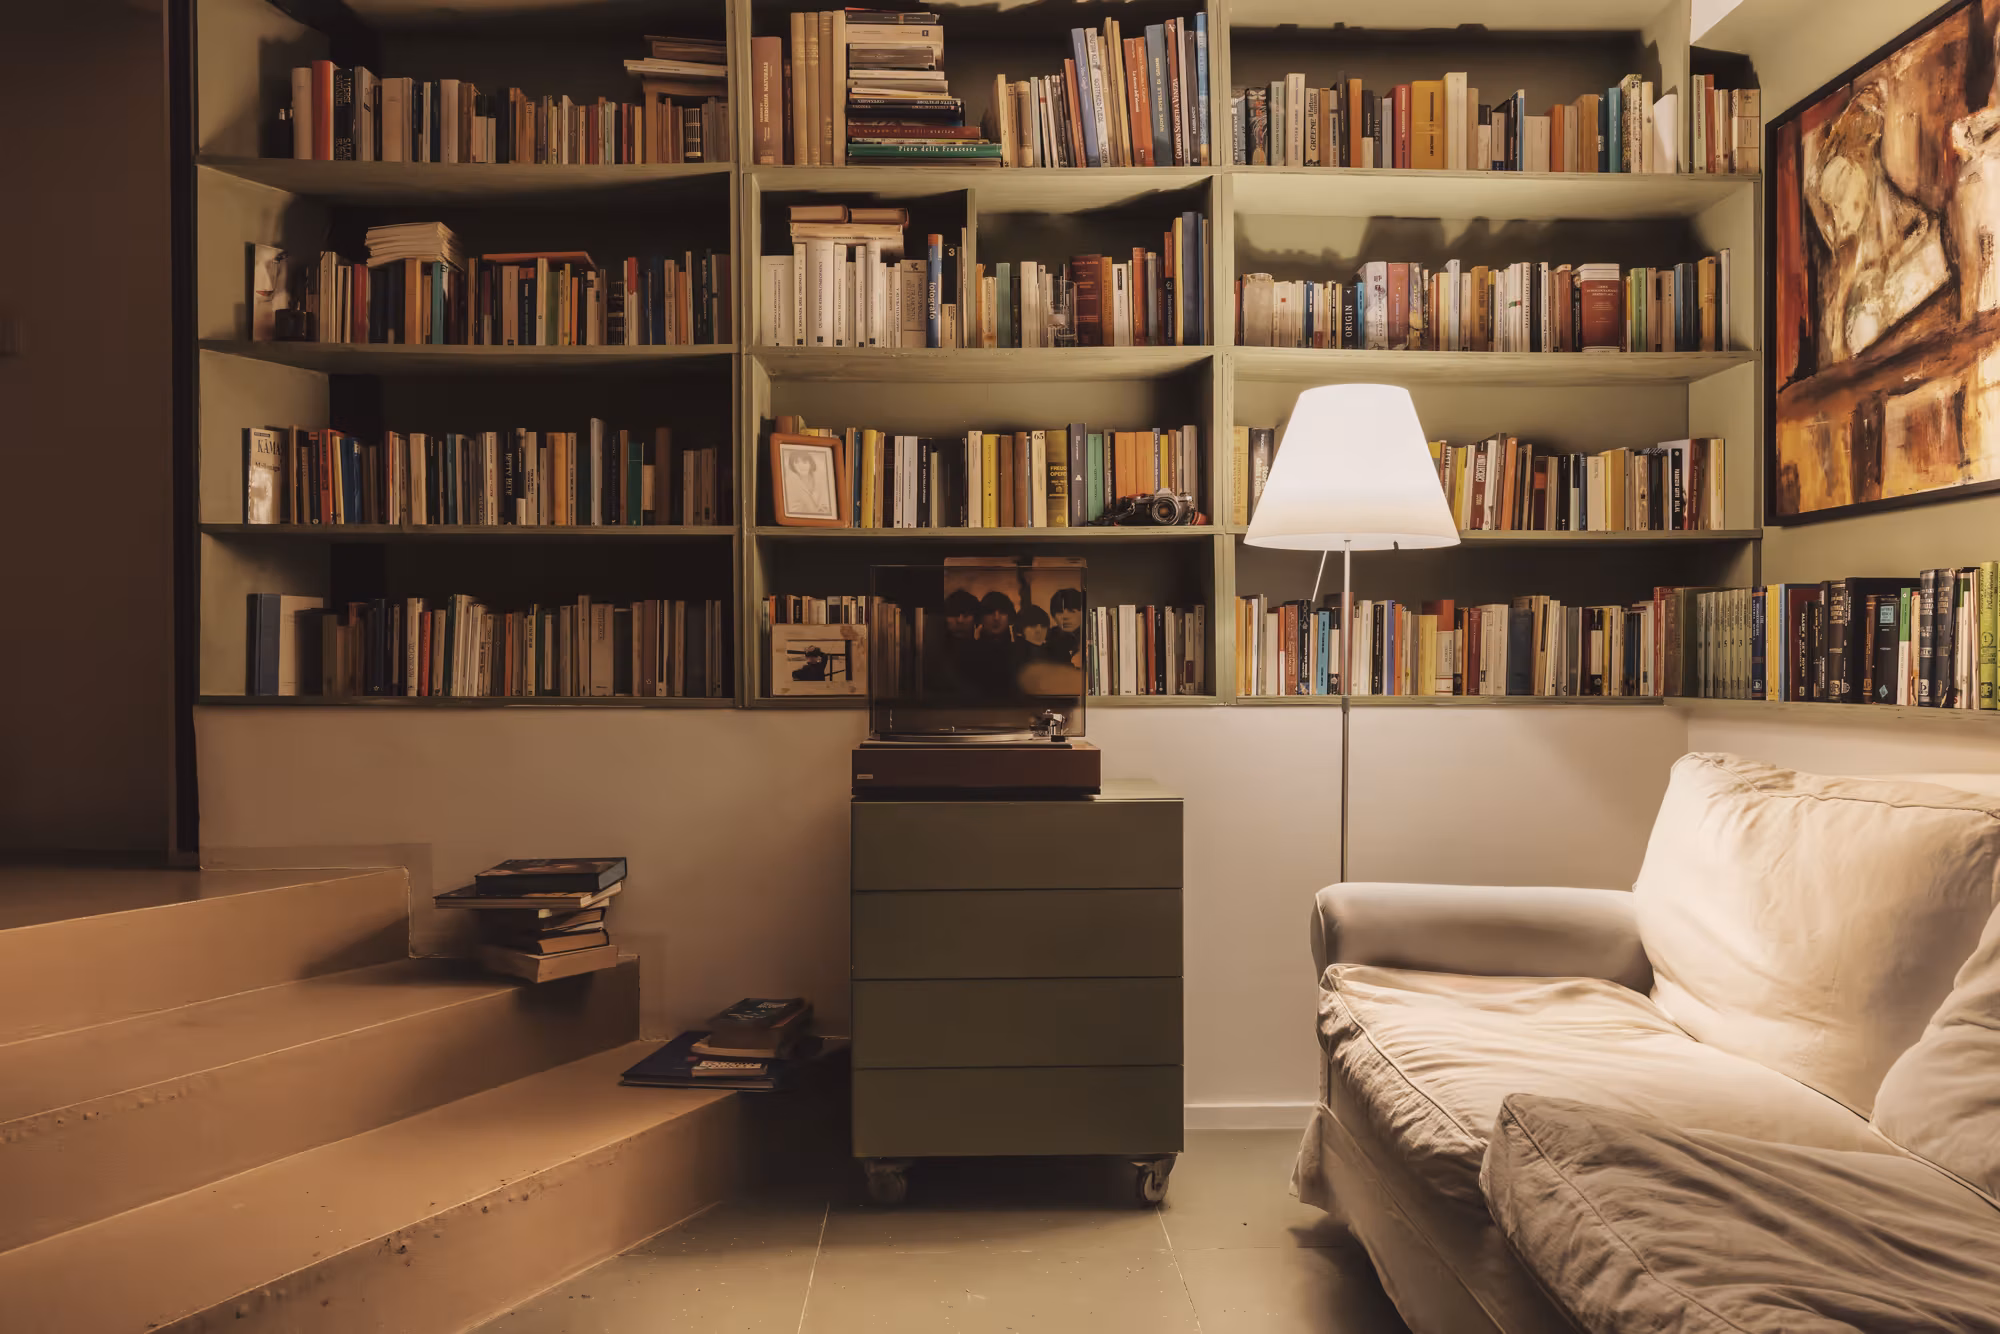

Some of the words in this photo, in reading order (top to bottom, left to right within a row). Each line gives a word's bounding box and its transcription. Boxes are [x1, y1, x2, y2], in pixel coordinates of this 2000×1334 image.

[928, 282, 936, 320] fotografo
[1345, 304, 1353, 338] ORIGIN
[1033, 432, 1045, 441] 65
